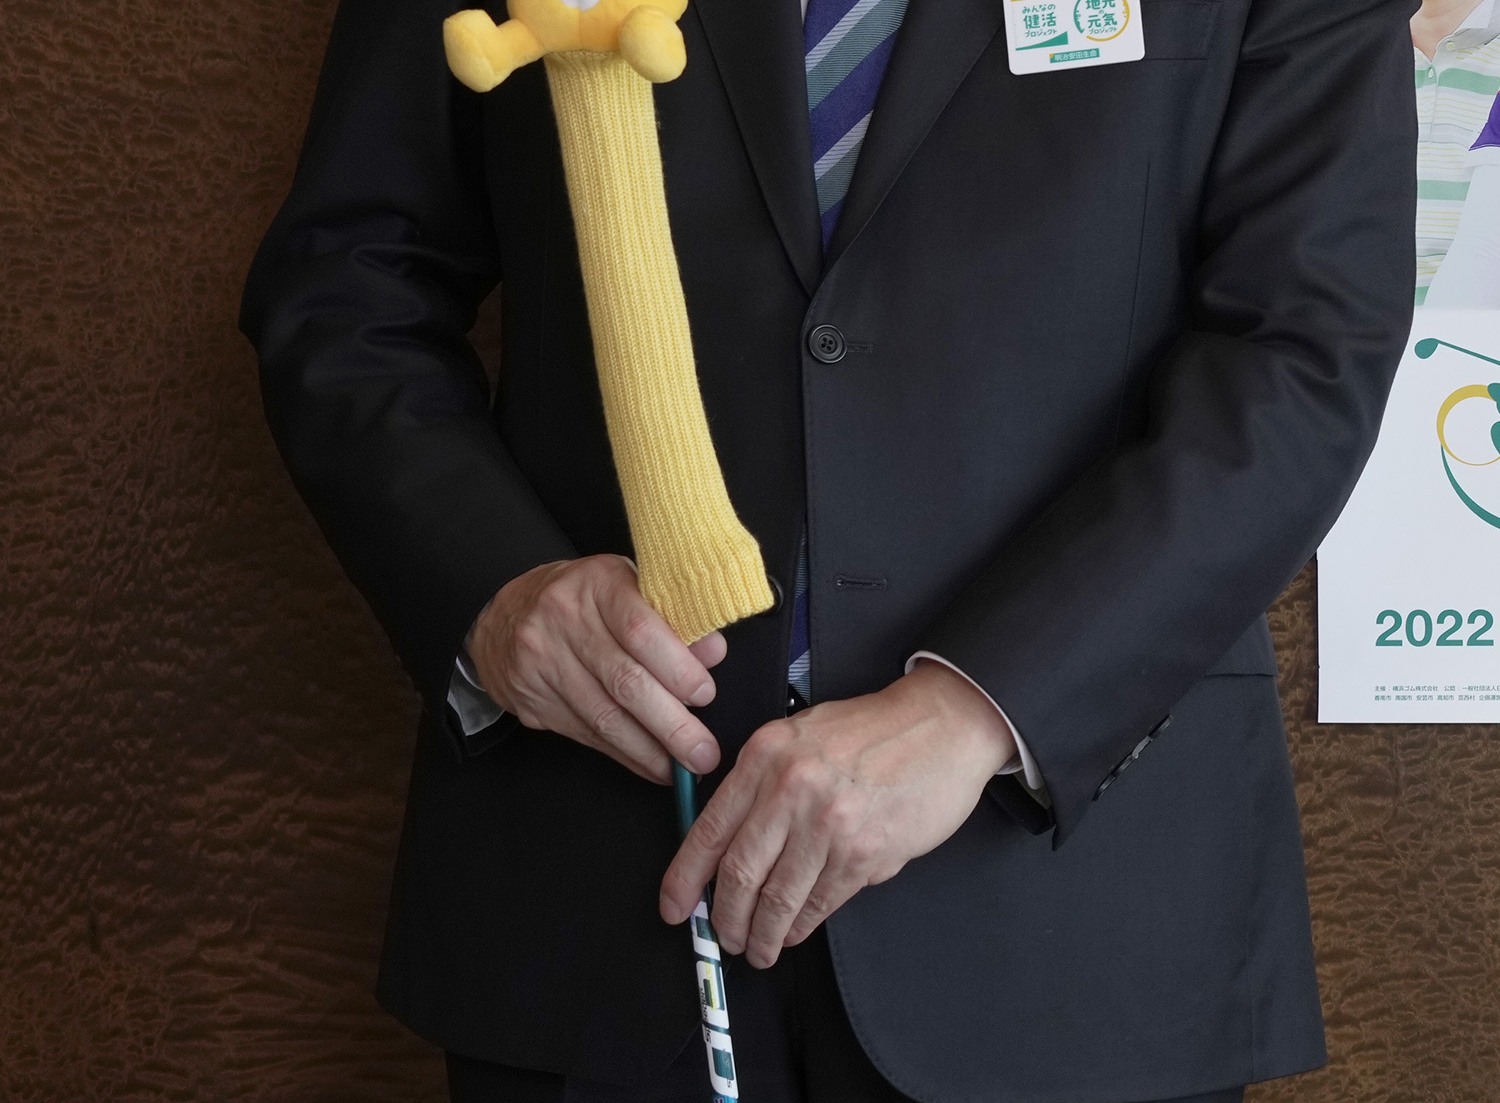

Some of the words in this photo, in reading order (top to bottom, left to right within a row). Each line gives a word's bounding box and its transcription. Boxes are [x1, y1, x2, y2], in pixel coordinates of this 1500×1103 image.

[1022, 3, 1056, 14] みんなの
[1023, 12, 1057, 29] 健活
[1087, 13, 1118, 28] 元気
[1024, 28, 1058, 38] プロジェクト
[1088, 26, 1118, 35] プロジェクト
[1054, 51, 1098, 62] 明治安田生命
[1375, 608, 1495, 648] 2022
